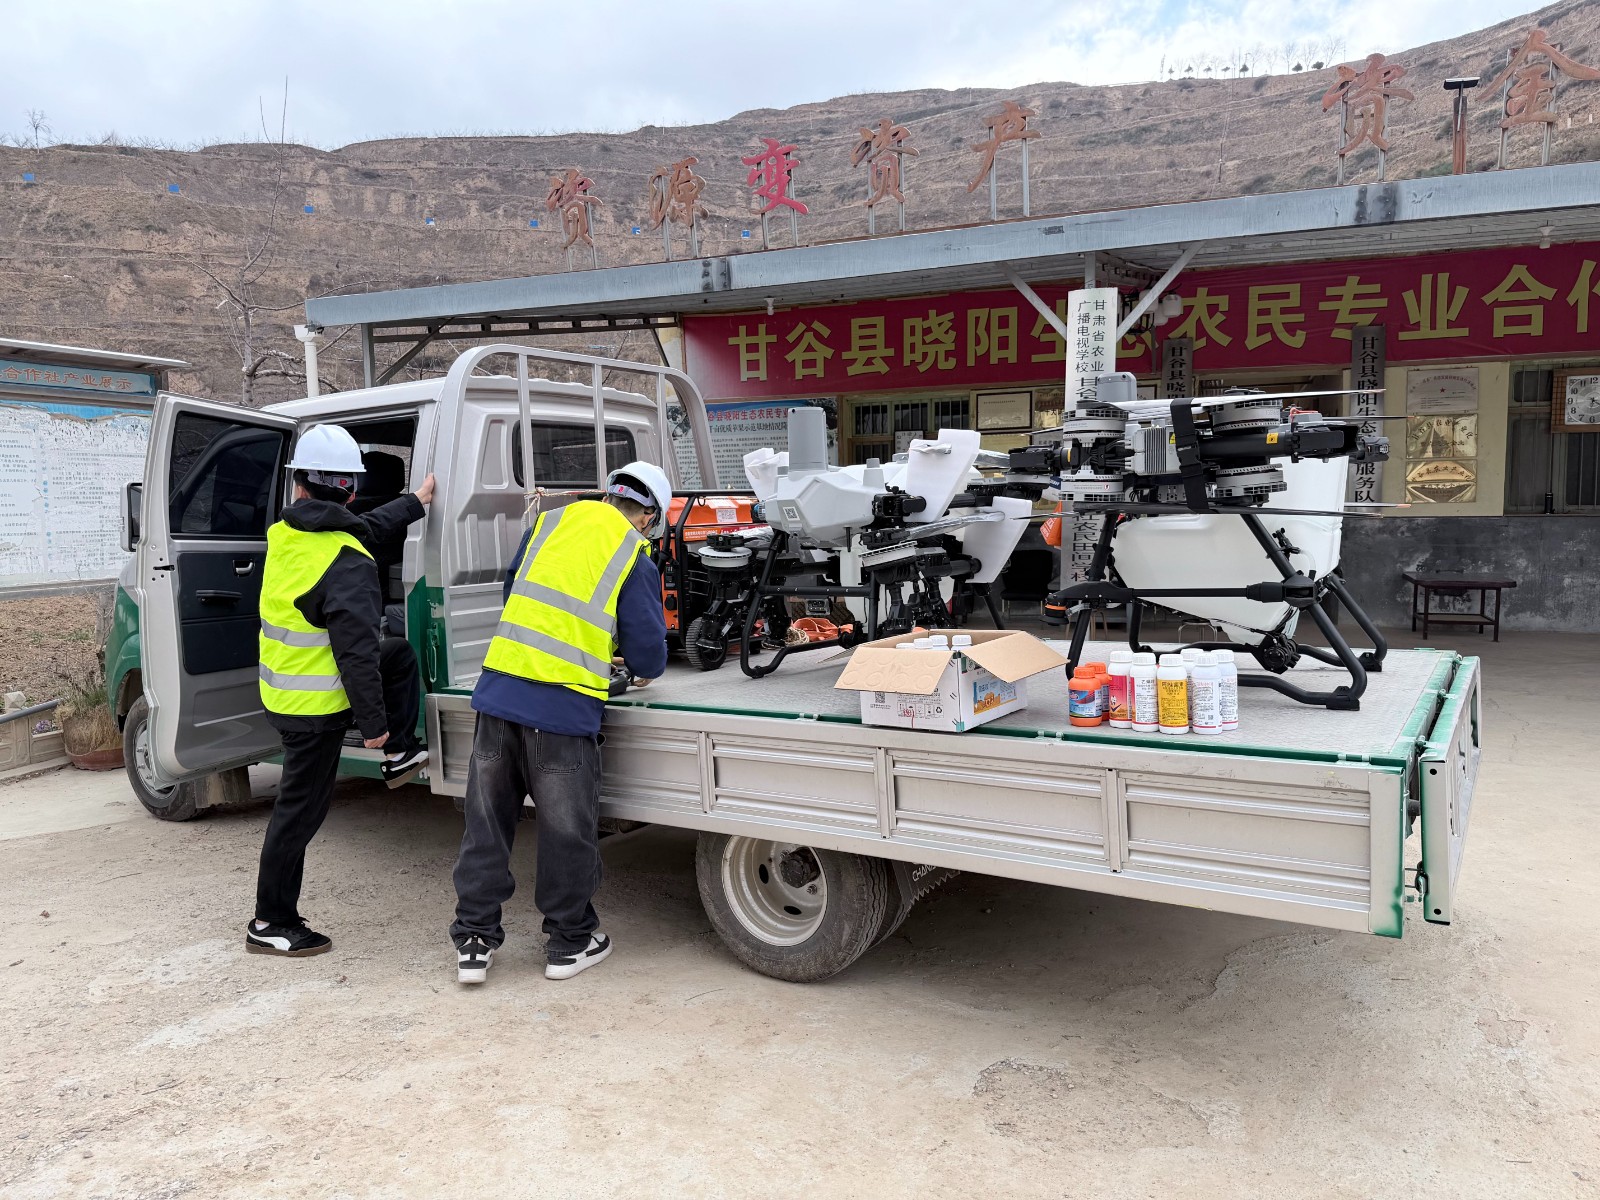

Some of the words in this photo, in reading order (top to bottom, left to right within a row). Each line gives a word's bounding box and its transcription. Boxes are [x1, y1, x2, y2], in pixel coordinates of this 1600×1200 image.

[1091, 299, 1107, 373] 甘肃省农业
[0, 366, 133, 391] 合作社产业展示
[1354, 336, 1379, 503] 甘谷县晓阳生态服务队
